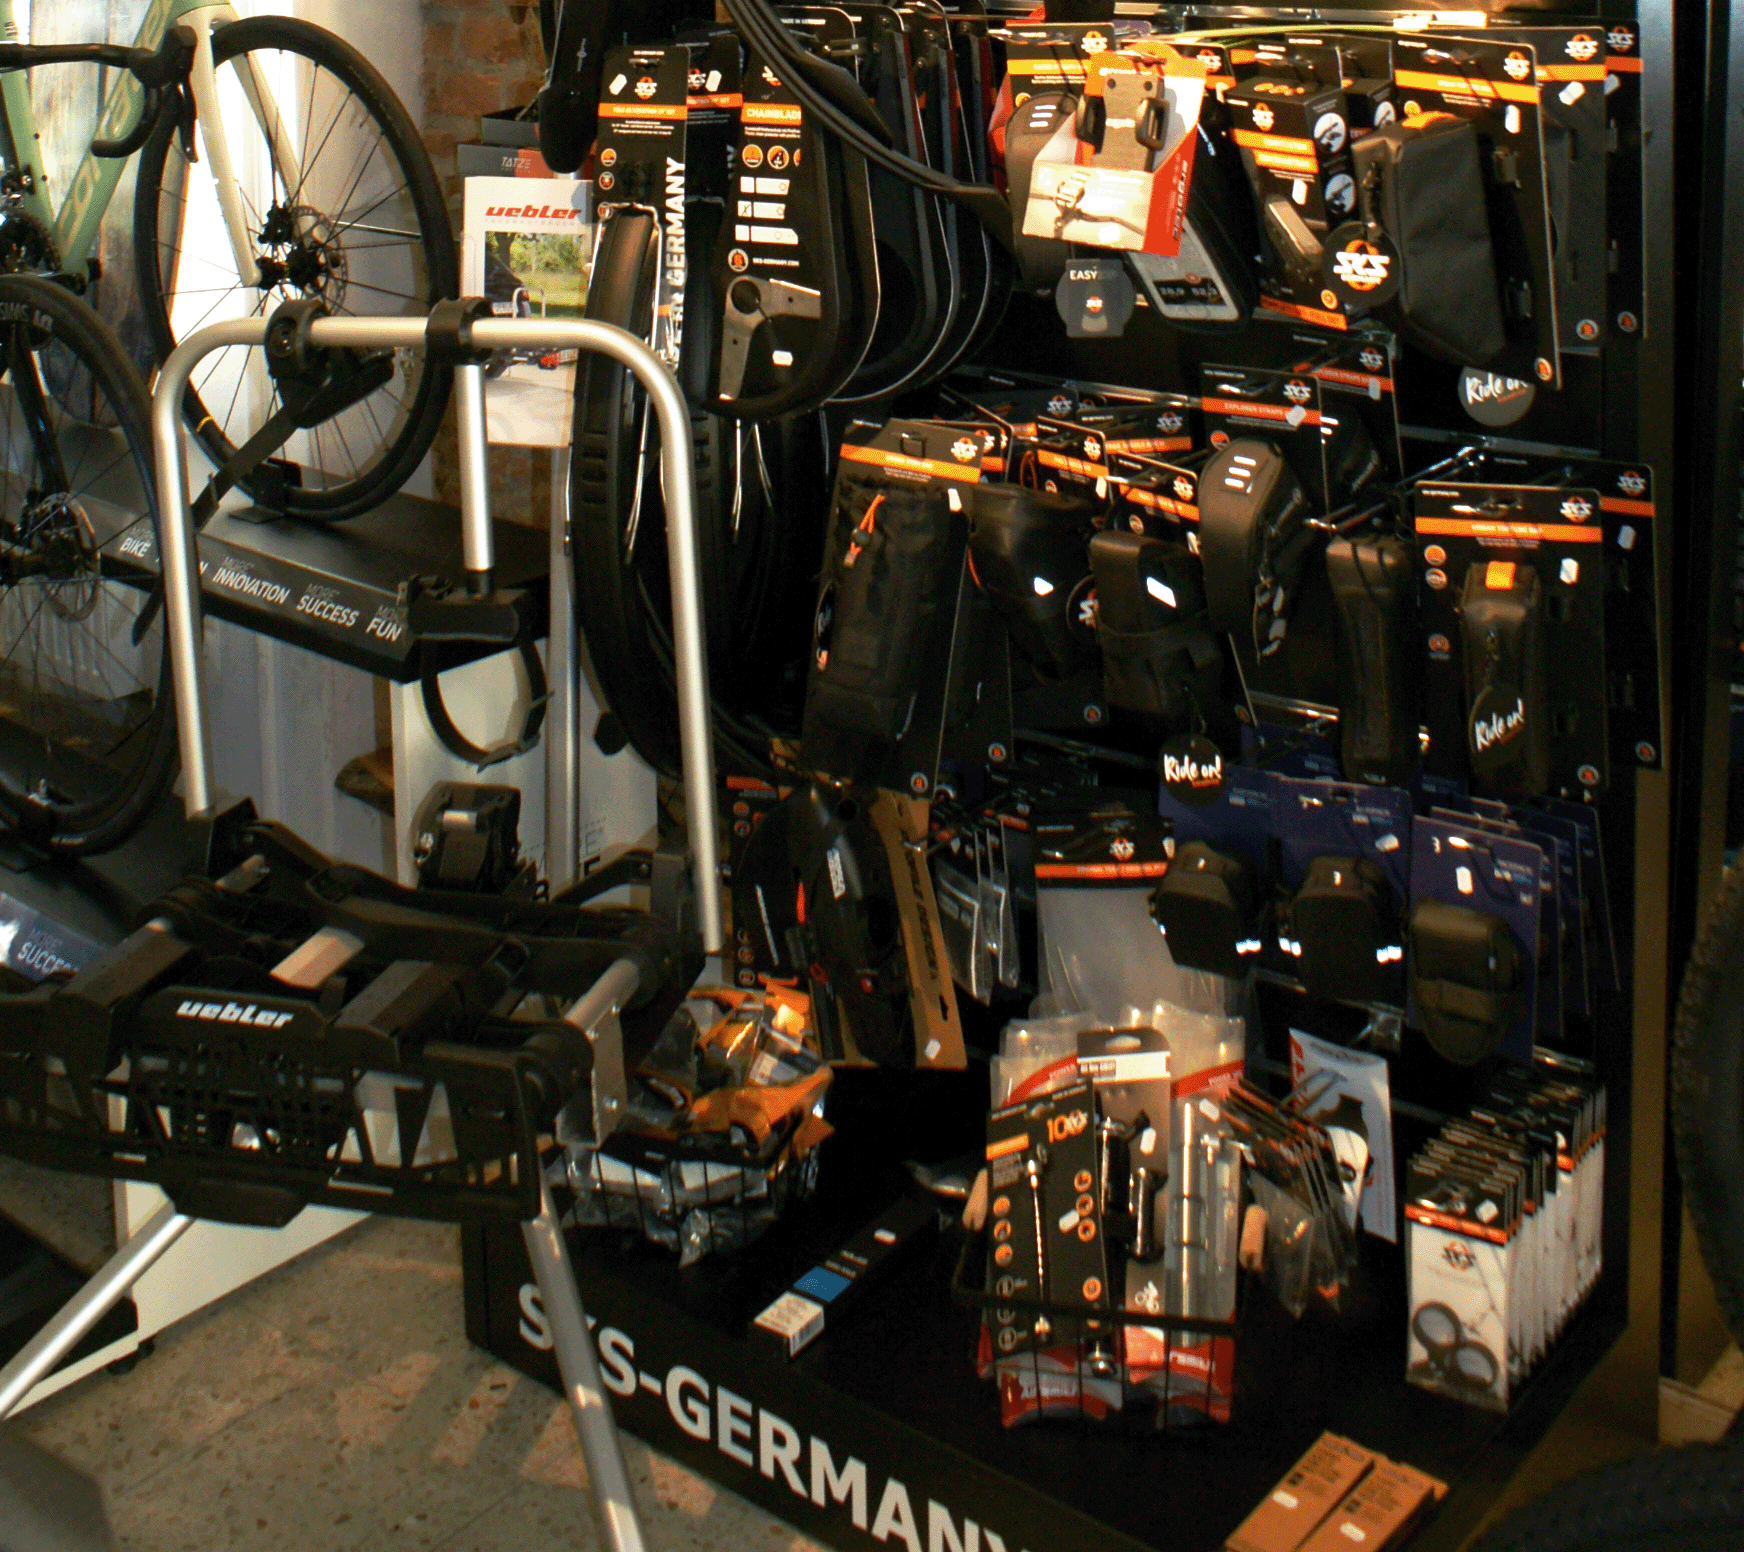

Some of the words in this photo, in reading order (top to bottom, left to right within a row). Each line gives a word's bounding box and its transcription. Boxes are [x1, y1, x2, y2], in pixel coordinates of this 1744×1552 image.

[485, 204, 582, 220] uebler
[665, 156, 686, 288] GERMANY
[1069, 269, 1098, 281] EASY
[1332, 250, 1391, 277] SKS
[1465, 371, 1505, 405] Ride
[119, 536, 152, 558] BIKE
[212, 566, 291, 605] INNOVATION
[296, 594, 360, 628] SUCCESS
[366, 617, 403, 643] FUN
[1473, 707, 1504, 752] Ride
[1163, 753, 1198, 784] Ride
[1199, 753, 1223, 781] on!
[17, 941, 80, 974] SUCCE
[175, 1000, 296, 1030] uebler
[518, 1282, 1029, 1552] SS-GERMAN
